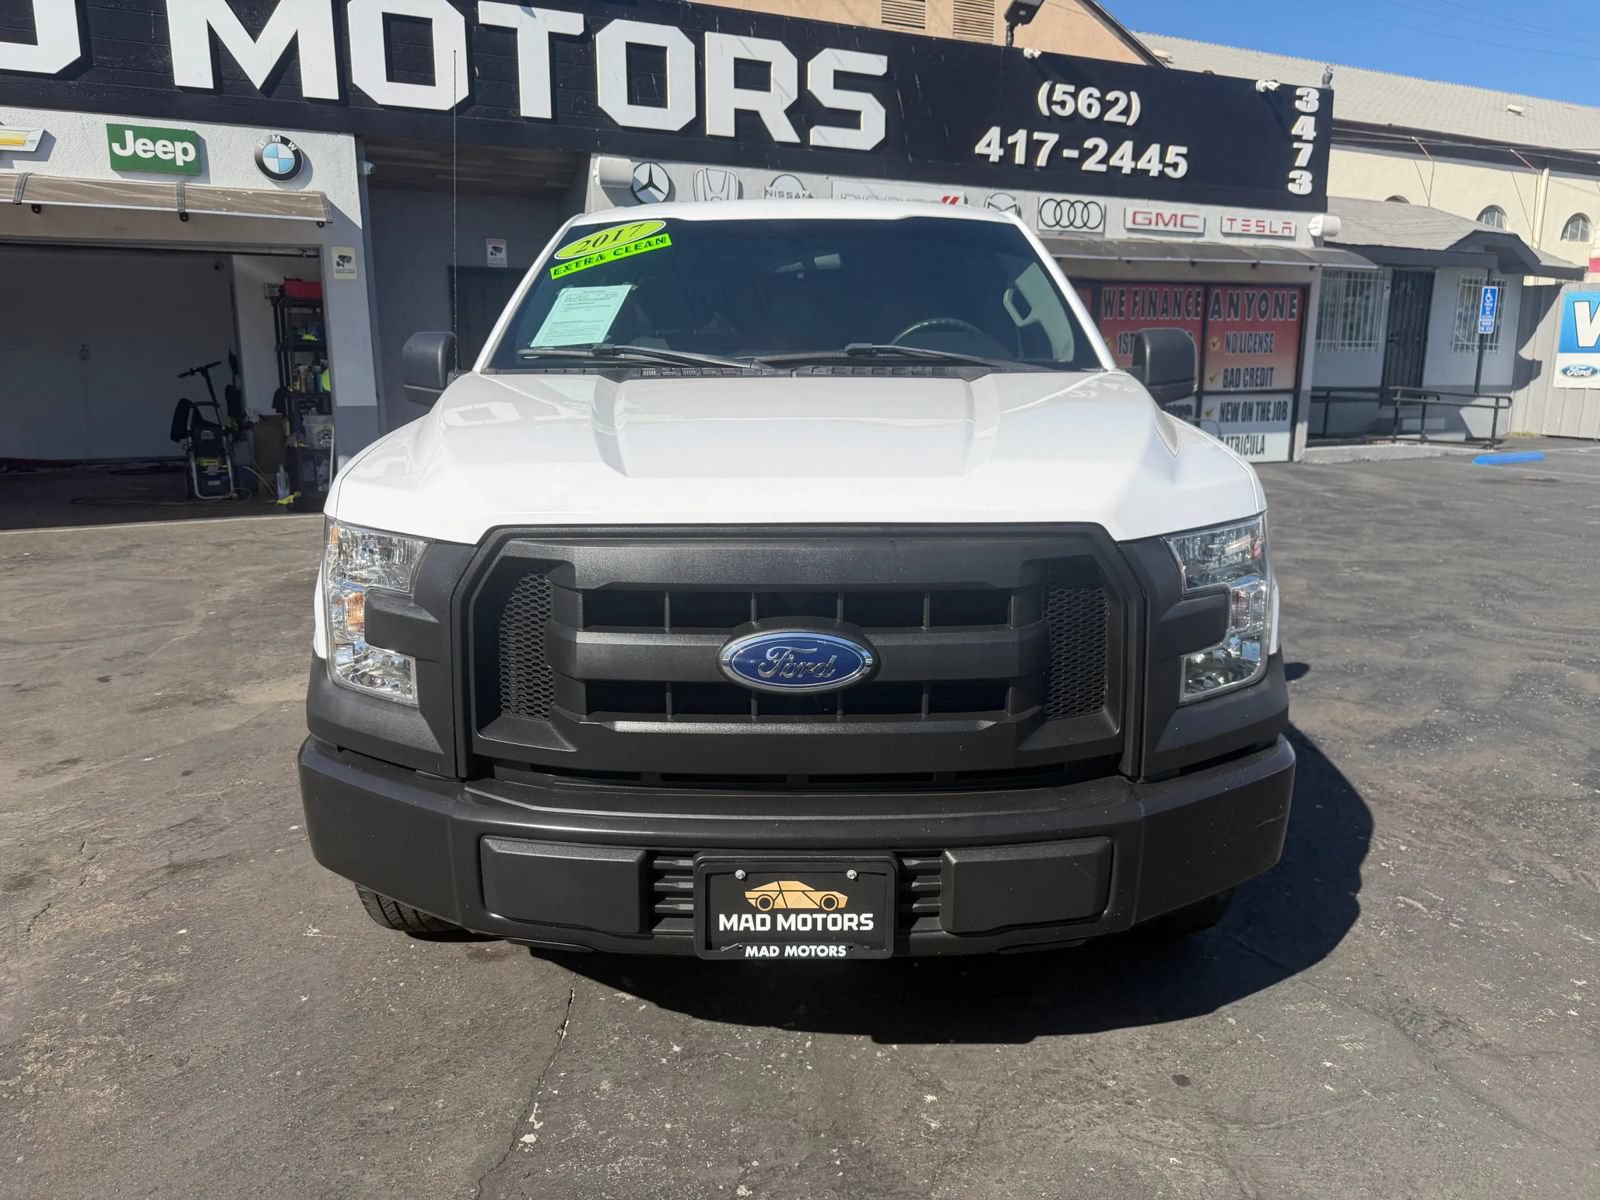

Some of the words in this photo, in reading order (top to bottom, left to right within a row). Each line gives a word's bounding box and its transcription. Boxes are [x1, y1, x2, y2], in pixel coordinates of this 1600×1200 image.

[167, 0, 888, 151] MOTORS
[1037, 80, 1141, 125] (562)
[111, 130, 196, 166] Jeep
[257, 134, 298, 152] BMW
[974, 126, 1188, 179] 417-2445
[766, 188, 809, 199] NISSAN
[1132, 210, 1200, 230] GMC
[1226, 217, 1293, 235] TESLA
[575, 224, 644, 254] 2017
[553, 254, 605, 276] EXTRA
[612, 236, 667, 256] CLEAN
[1102, 288, 1126, 320] WE
[1131, 288, 1201, 320] FINANCE
[1208, 290, 1298, 322] ANYONE
[1224, 331, 1241, 355] NO
[1241, 331, 1274, 354] LICENSE
[1223, 367, 1241, 389] BAD
[1243, 367, 1274, 388] CREDIT
[1219, 402, 1240, 423] NEW
[1242, 402, 1254, 422] ON
[1256, 401, 1271, 422] THE
[1271, 400, 1288, 421] JOB
[757, 646, 838, 678] Ford
[719, 913, 771, 931] MAD
[776, 913, 874, 931] MOTORS
[745, 945, 780, 957] MAD
[785, 945, 847, 957] MOTORS
